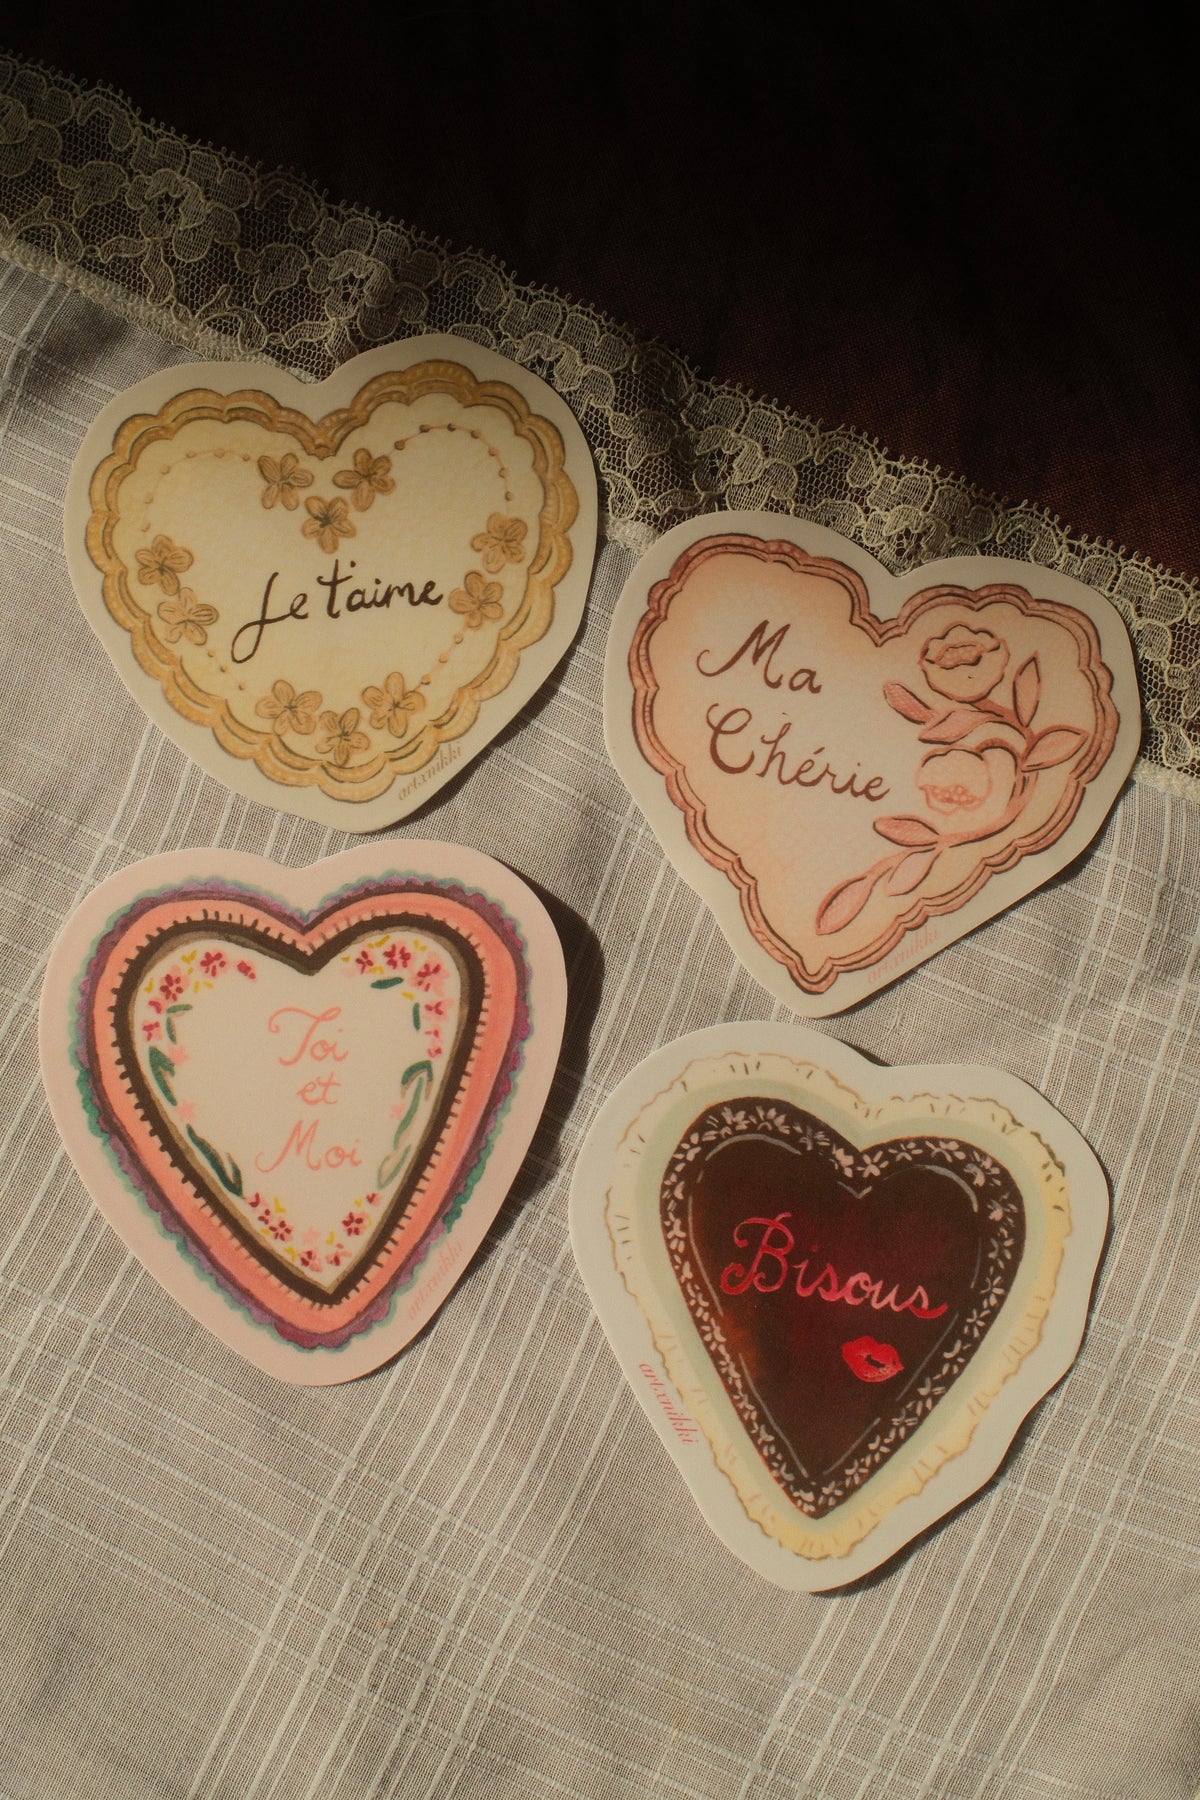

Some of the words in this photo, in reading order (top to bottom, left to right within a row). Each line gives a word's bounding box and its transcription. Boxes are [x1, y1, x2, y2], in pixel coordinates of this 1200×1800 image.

[231, 572, 309, 663] Je
[697, 620, 822, 693] Ma
[706, 703, 890, 801] Chérie
[268, 1006, 348, 1066] Toi
[296, 1072, 341, 1105] et
[255, 1119, 362, 1173] Moi
[720, 1212, 948, 1319] Bisous
[639, 1364, 699, 1443] artxnikki
